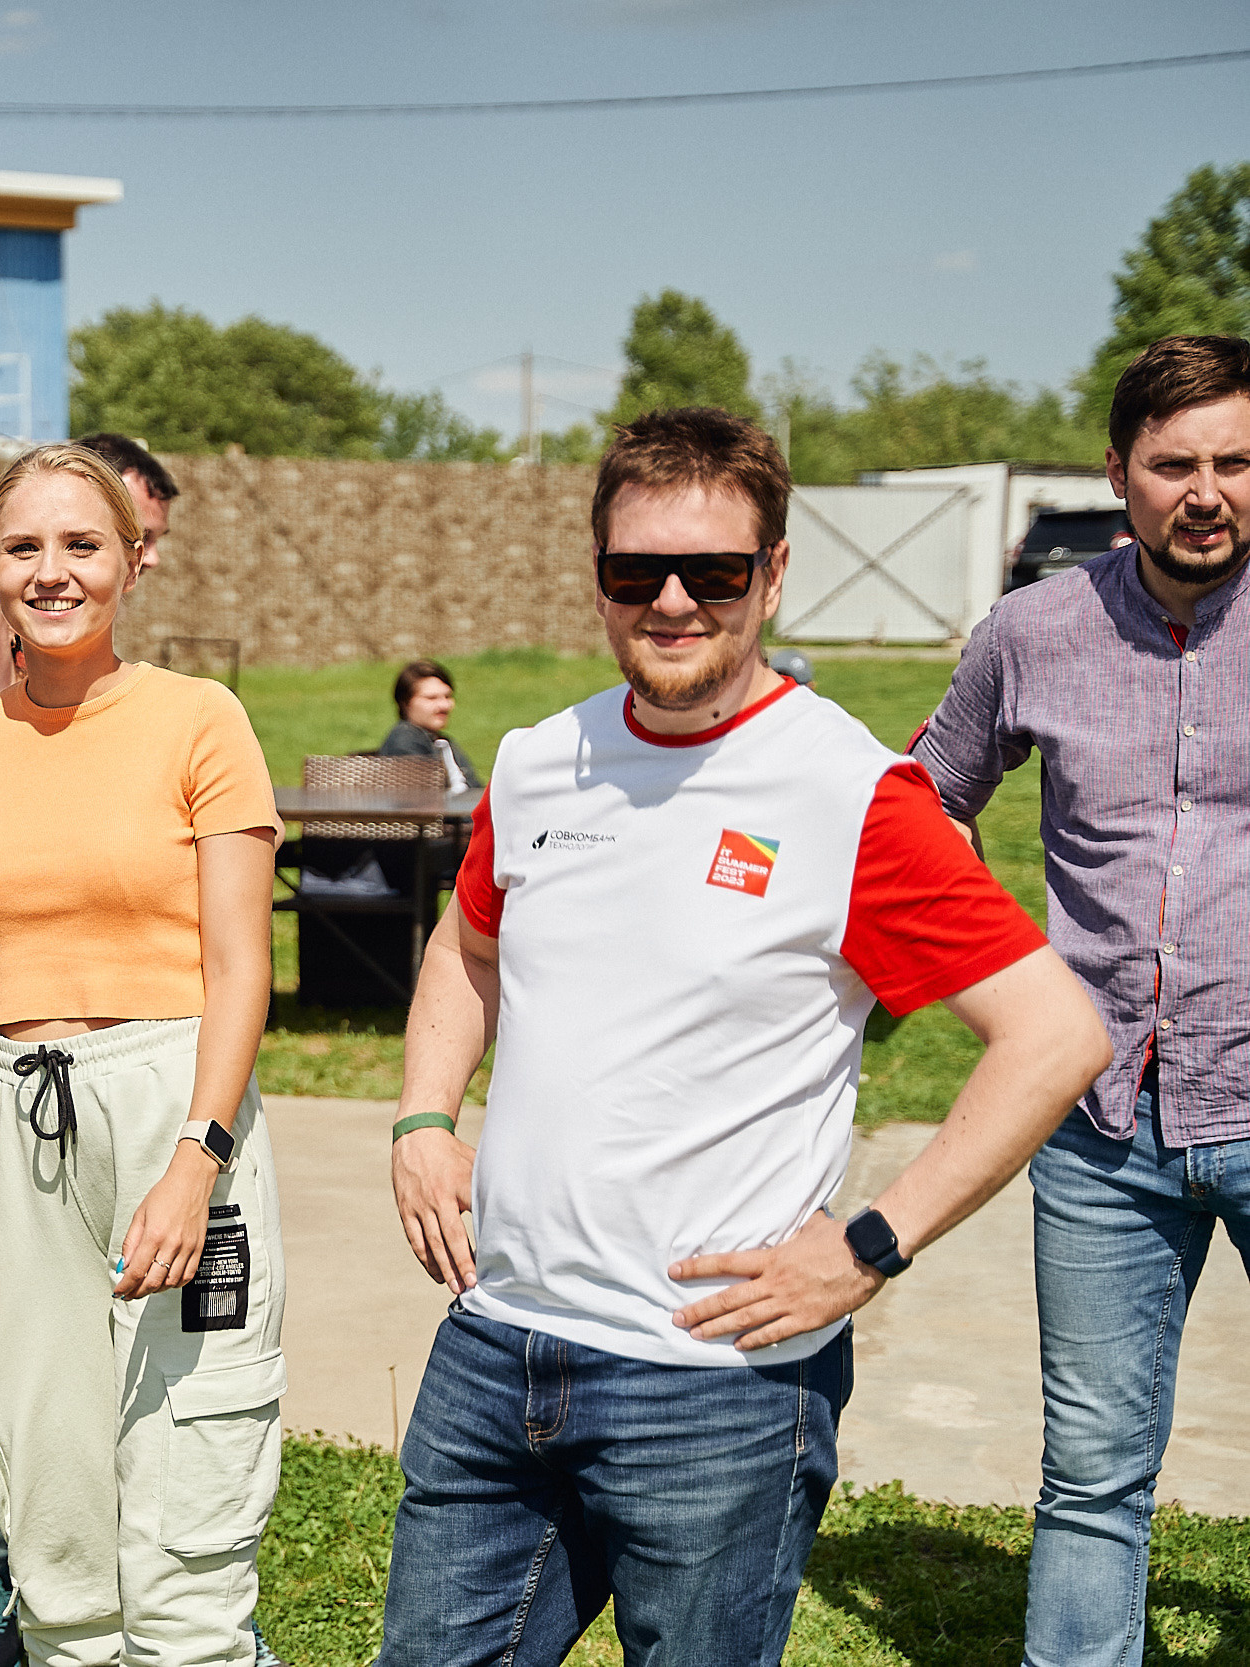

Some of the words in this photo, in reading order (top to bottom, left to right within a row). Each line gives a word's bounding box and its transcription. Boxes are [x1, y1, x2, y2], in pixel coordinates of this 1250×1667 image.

[550, 830, 619, 843] СОВКОМБАНК
[715, 864, 746, 877] FEST
[718, 856, 769, 875] SUMMER
[712, 873, 745, 886] 2023
